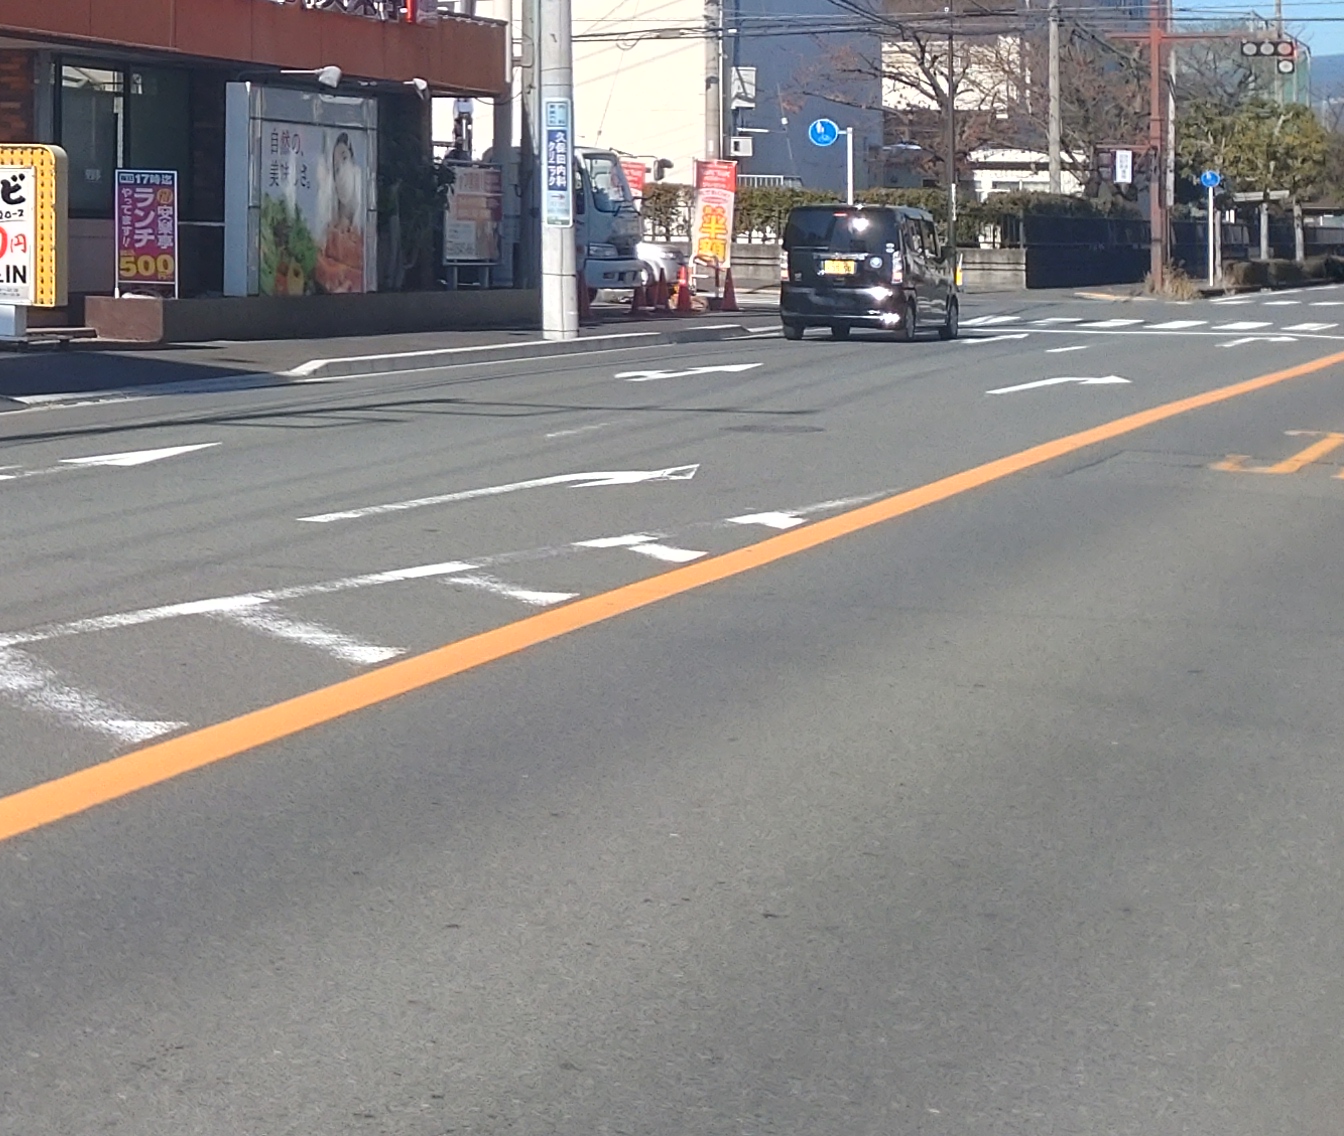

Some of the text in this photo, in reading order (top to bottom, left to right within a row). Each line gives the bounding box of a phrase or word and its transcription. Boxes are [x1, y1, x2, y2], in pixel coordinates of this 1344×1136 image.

[134, 187, 156, 248] ランチ
[6, 264, 27, 284] IN
[119, 254, 175, 277] 500
